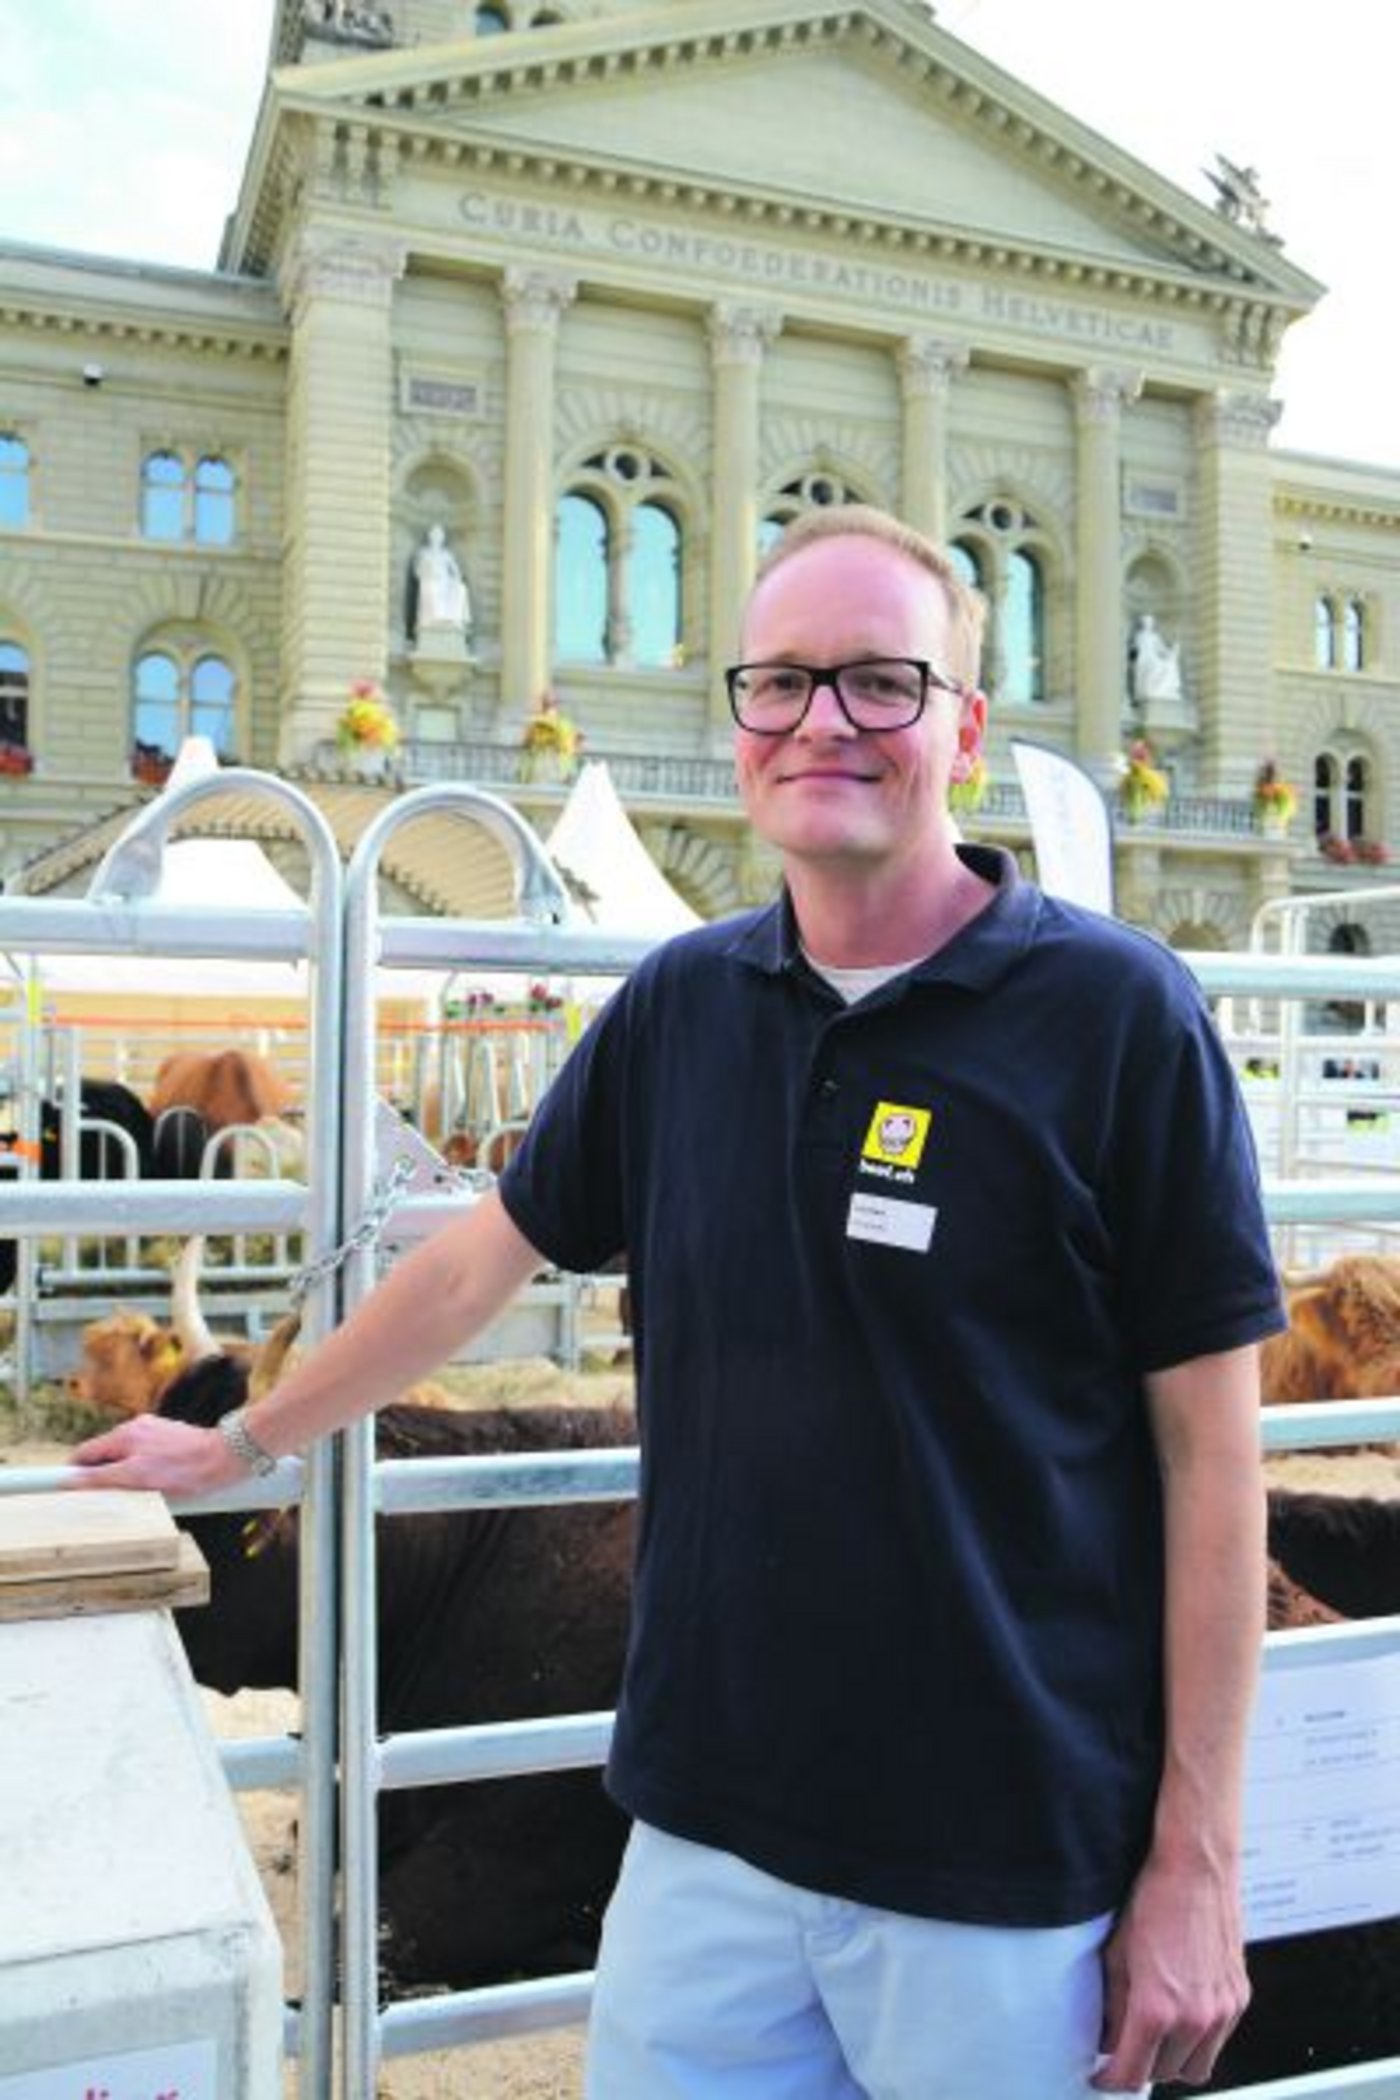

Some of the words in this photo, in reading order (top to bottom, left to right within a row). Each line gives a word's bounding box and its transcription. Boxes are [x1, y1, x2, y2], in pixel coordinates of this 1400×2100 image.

[458, 190, 584, 241] CURIA
[608, 218, 962, 310] CONFOEDERATIONIS
[980, 284, 1174, 350] HELVETICAE
